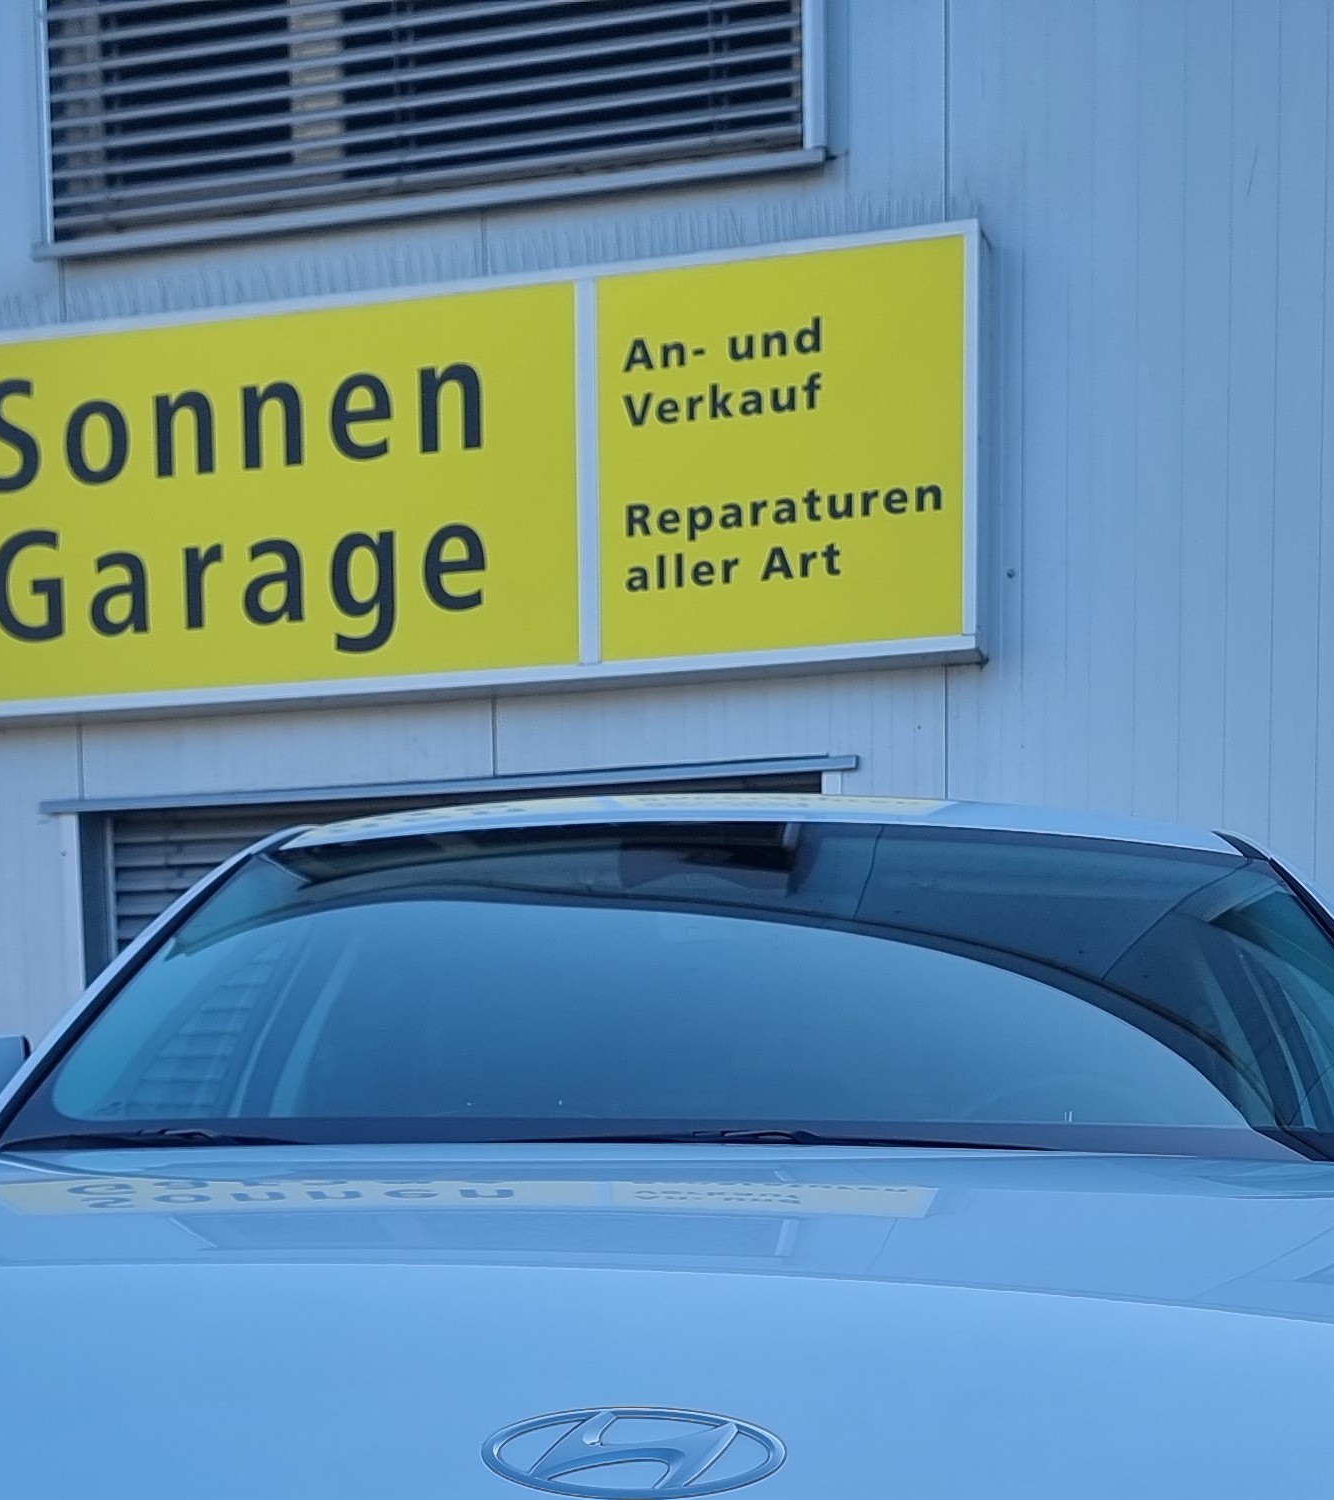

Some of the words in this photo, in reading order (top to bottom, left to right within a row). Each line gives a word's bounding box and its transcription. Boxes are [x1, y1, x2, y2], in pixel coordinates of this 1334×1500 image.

[622, 337, 707, 374] An-
[727, 315, 823, 363] und
[622, 370, 823, 428] Verkauf
[624, 483, 944, 543] Reparaturen
[624, 551, 741, 594] aller
[760, 541, 843, 583] Art
